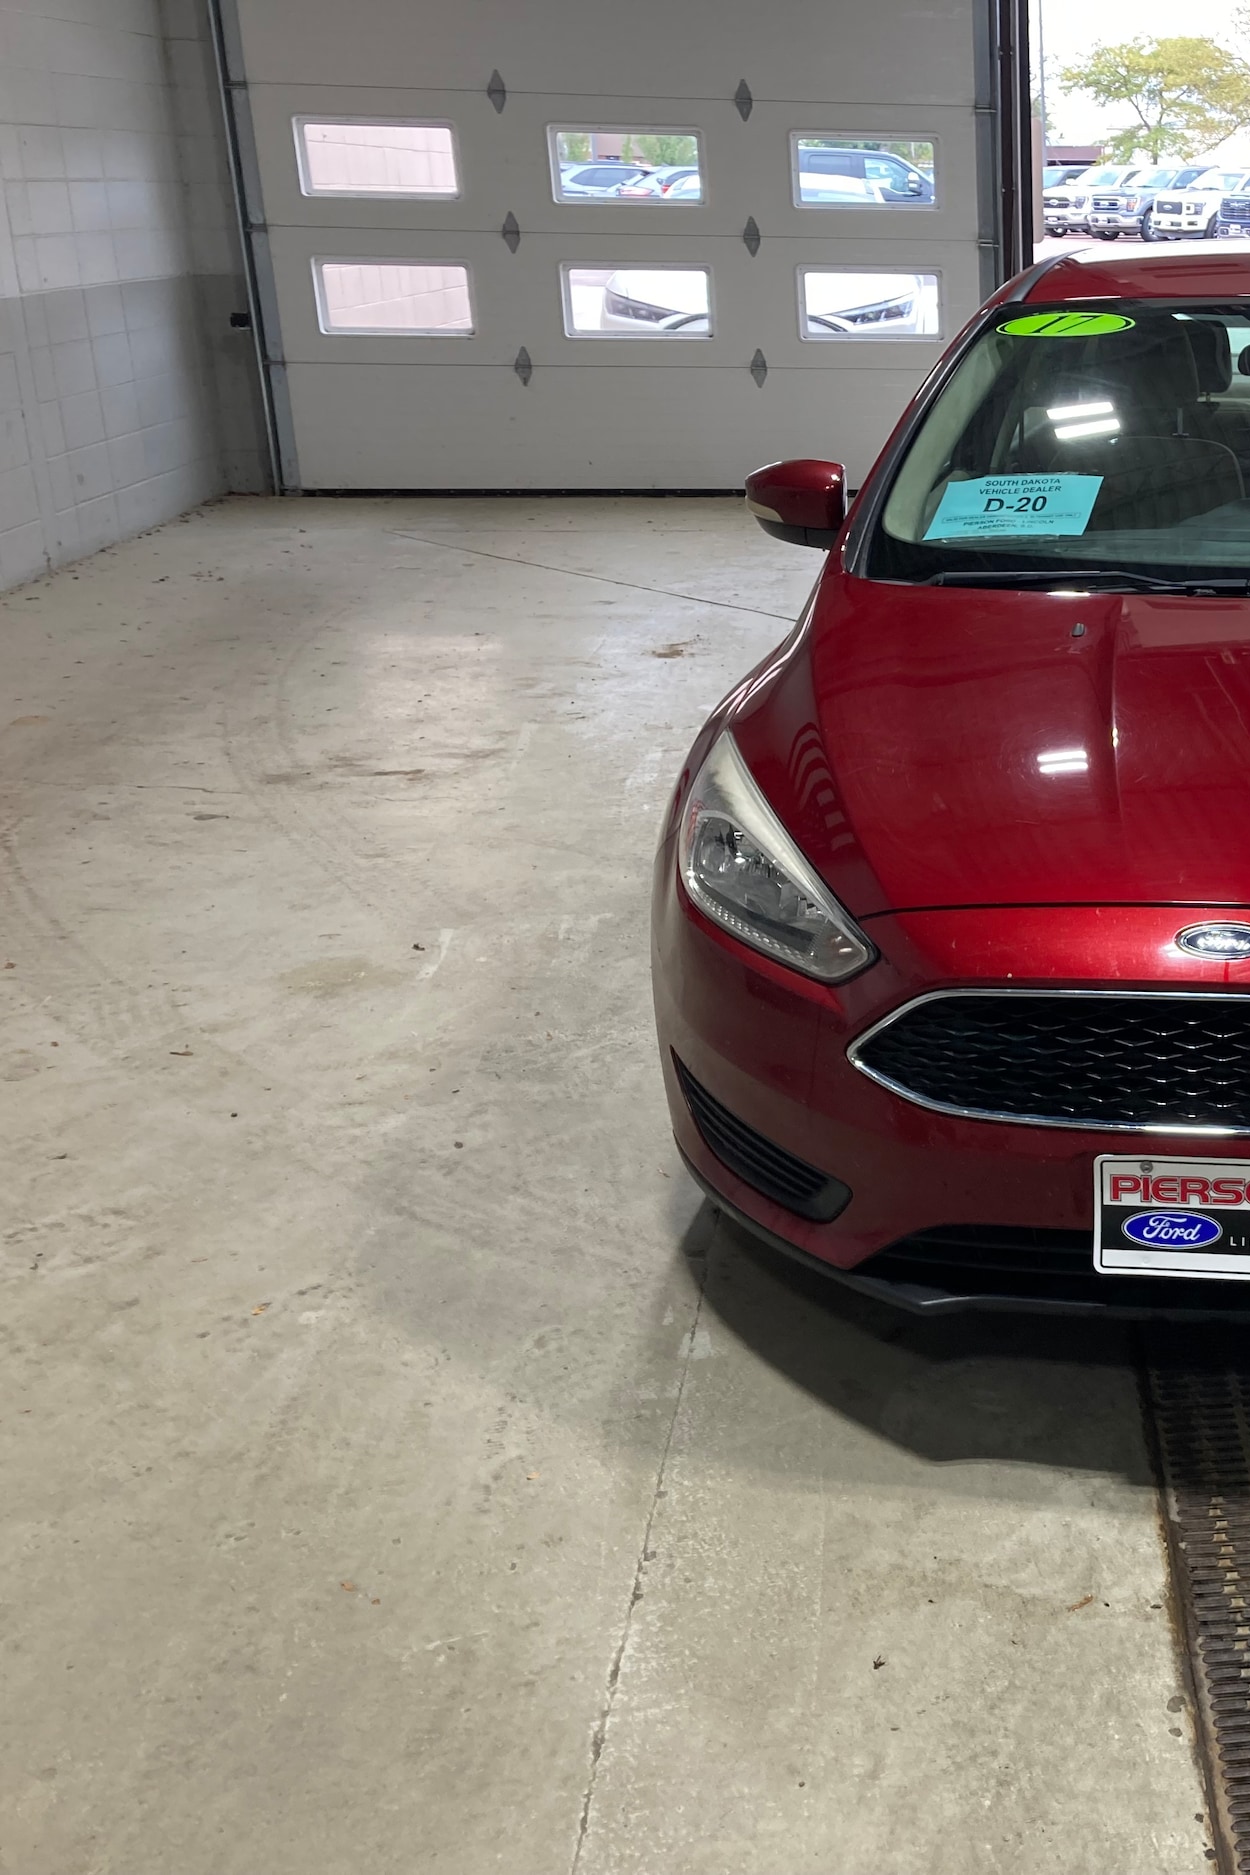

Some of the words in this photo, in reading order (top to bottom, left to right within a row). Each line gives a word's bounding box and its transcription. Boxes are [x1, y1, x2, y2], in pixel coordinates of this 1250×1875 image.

[1020, 478, 1061, 486] DAKOTA
[983, 495, 1048, 513] D-20
[1142, 1215, 1202, 1241] Ford
